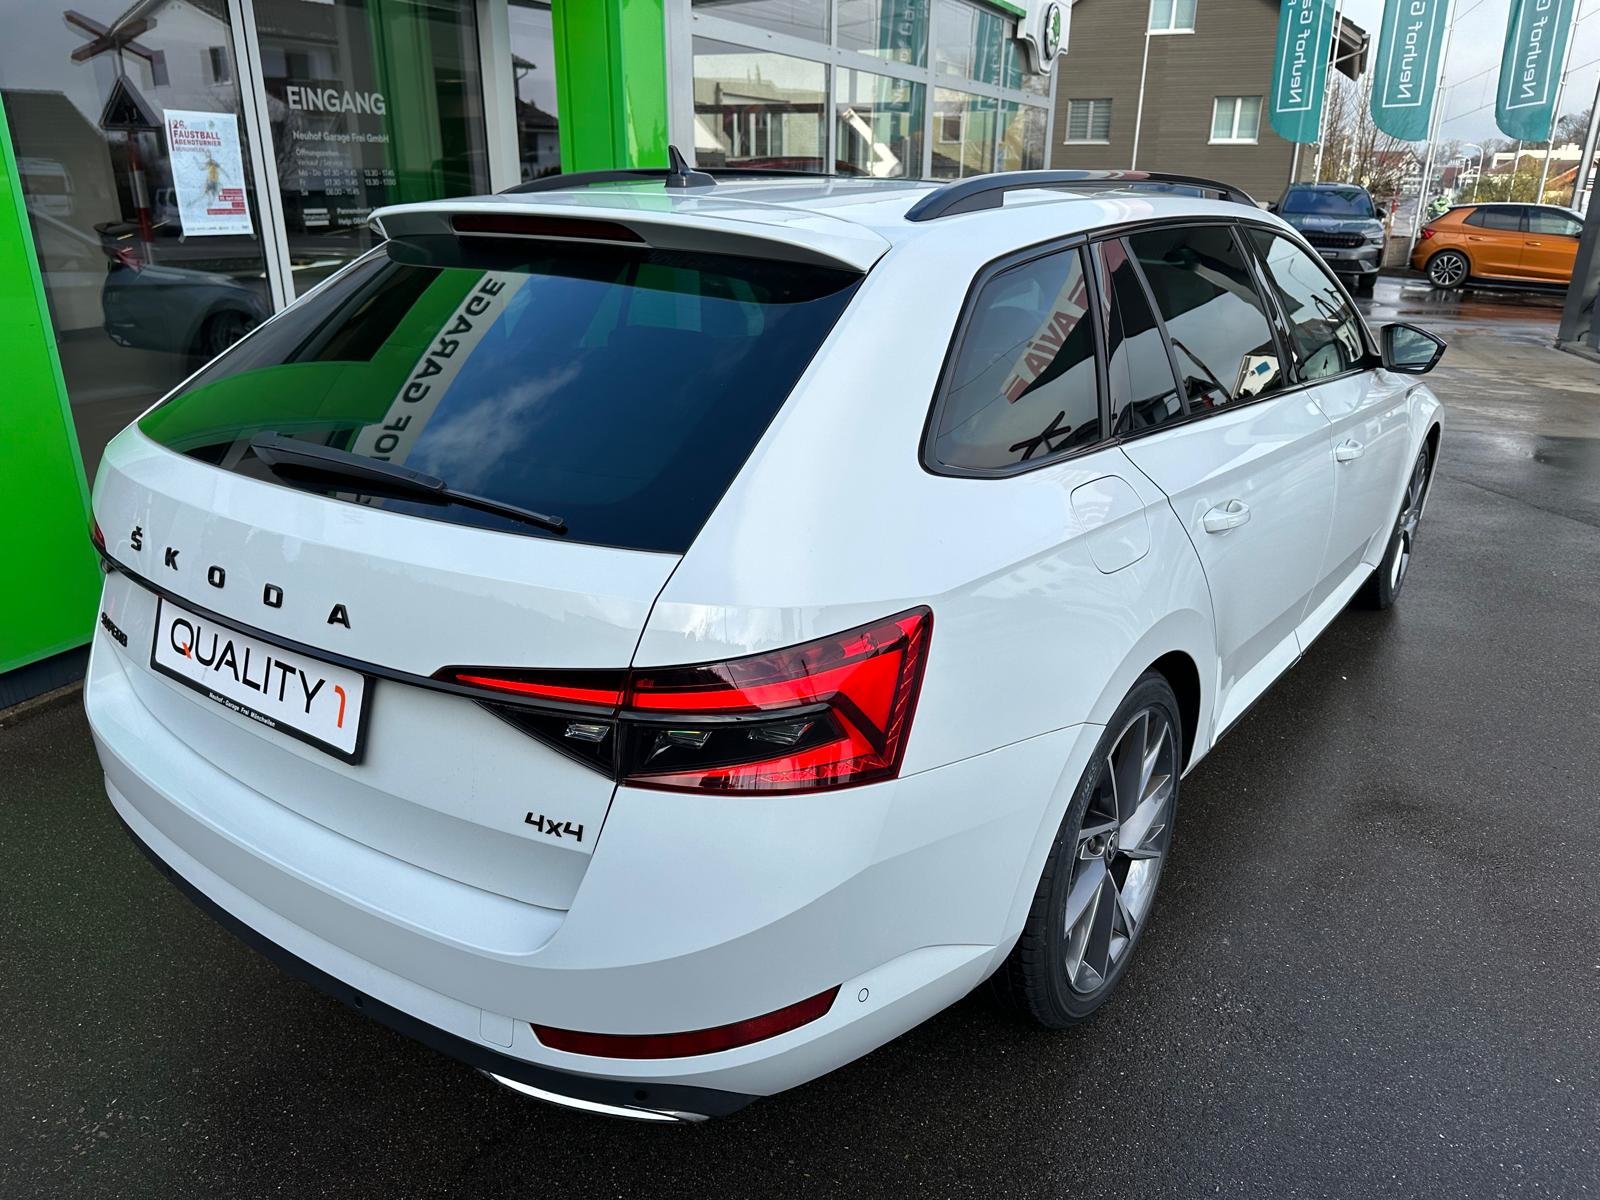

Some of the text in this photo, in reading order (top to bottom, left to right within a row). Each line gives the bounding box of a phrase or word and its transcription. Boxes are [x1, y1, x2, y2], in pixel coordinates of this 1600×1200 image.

[286, 85, 386, 115] EINGANG
[173, 130, 221, 140] FAUSTBALL
[292, 130, 390, 143] Neuhof Garage Frei GmbH
[130, 526, 351, 629] ŠKODA
[170, 617, 326, 714] QUALITY
[240, 706, 250, 716] Frei
[524, 811, 584, 842] 4x4
